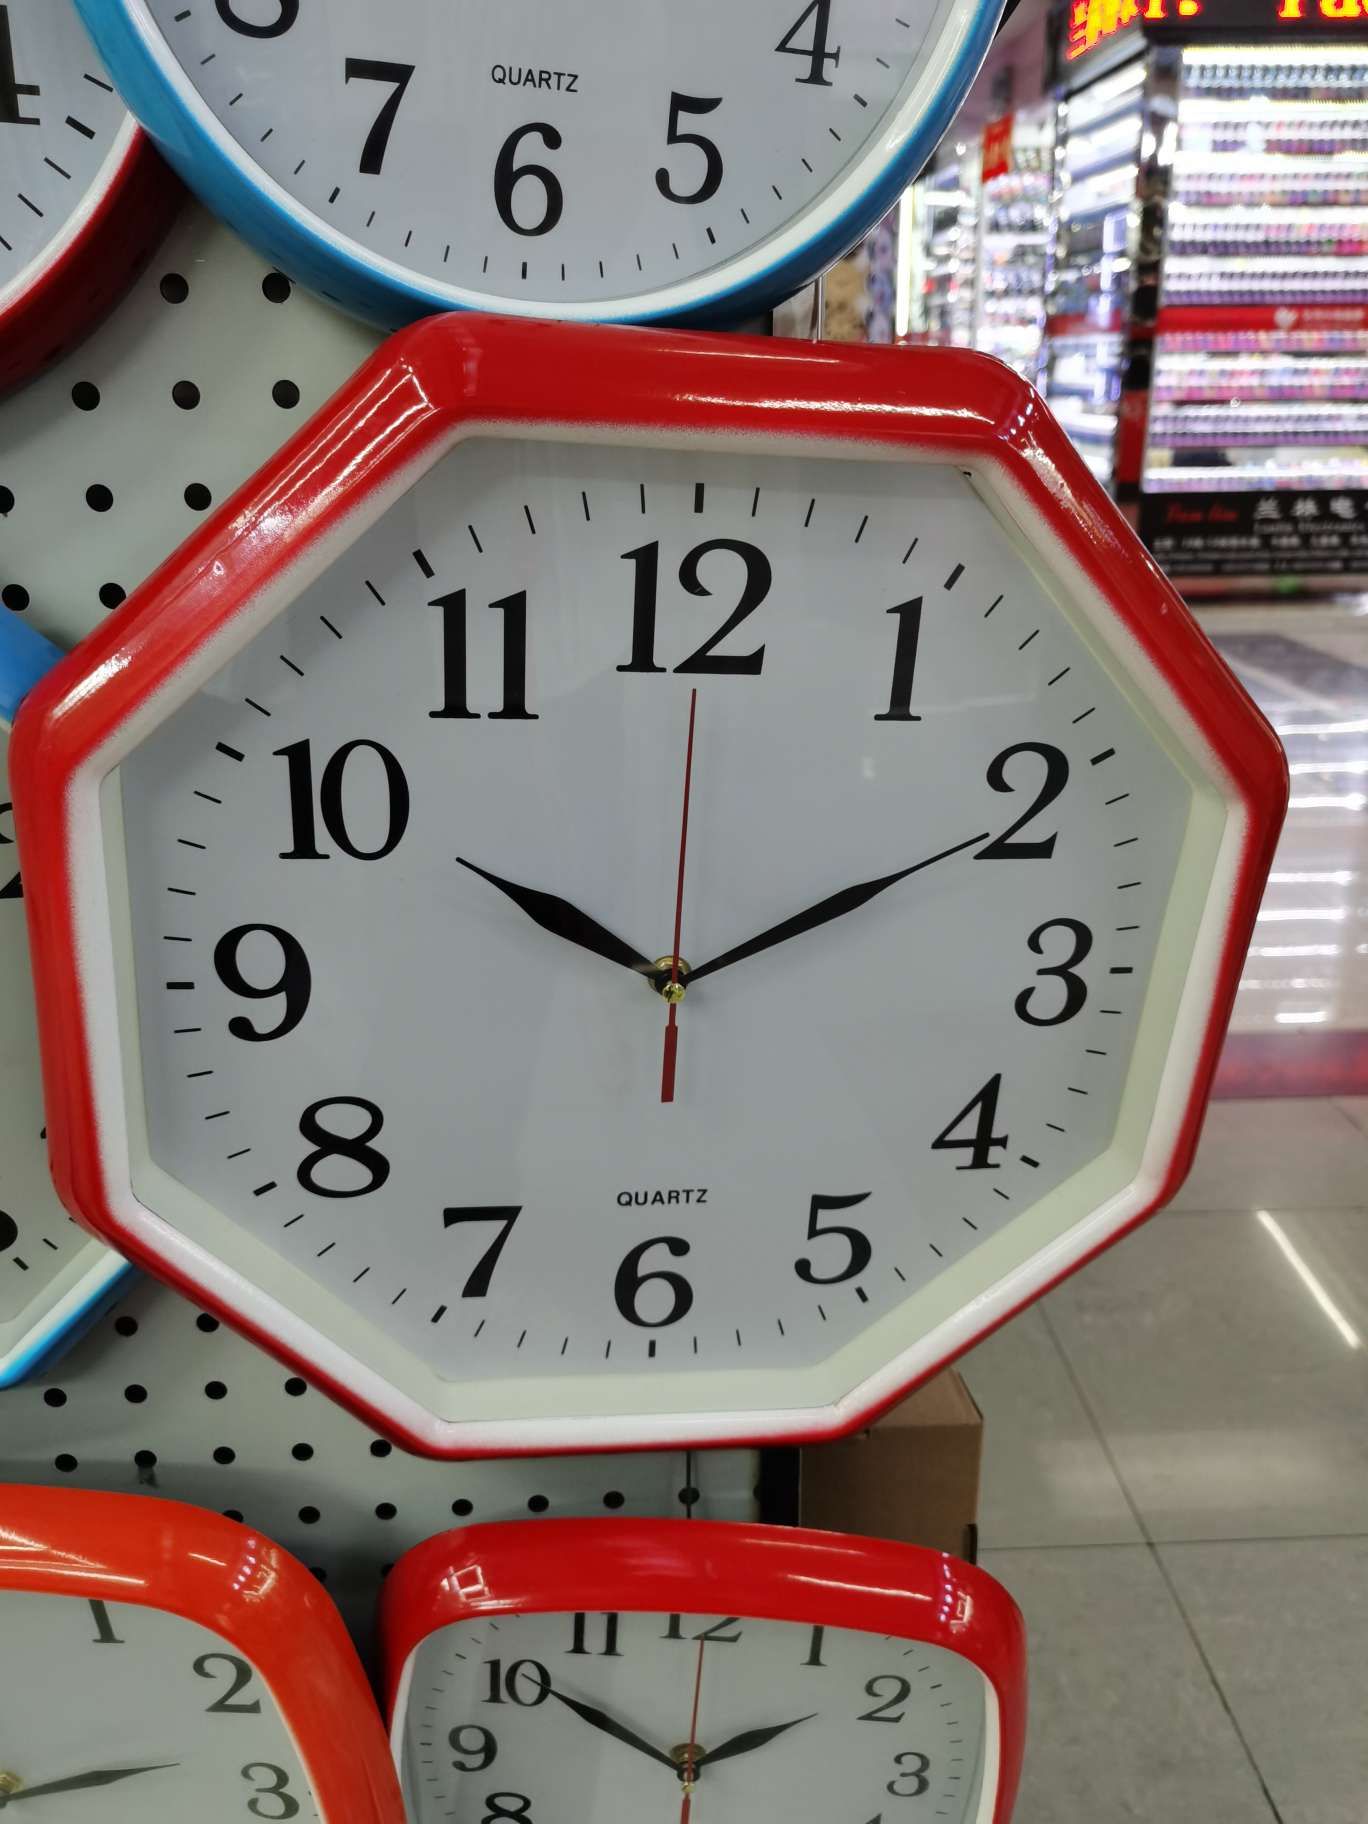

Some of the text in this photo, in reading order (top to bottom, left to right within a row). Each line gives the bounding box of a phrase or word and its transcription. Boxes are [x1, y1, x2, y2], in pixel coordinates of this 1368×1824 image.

[491, 64, 579, 93] QUARTZ
[775, 0, 841, 86] 4
[345, 57, 415, 175] 7
[655, 91, 723, 205] 5
[493, 122, 563, 237] 6
[427, 587, 540, 721] 11
[616, 539, 773, 676] 12
[874, 595, 924, 722] 1
[272, 738, 410, 862] 10
[973, 741, 1070, 861] 2
[214, 923, 312, 1043] 9
[1014, 917, 1093, 1027] 3
[297, 1095, 391, 1199] 8
[931, 1072, 1009, 1171] 4
[616, 1188, 708, 1207] QUARTZ
[794, 1191, 872, 1286] 5
[443, 1205, 522, 1299] 7
[614, 1235, 694, 1328] 6
[564, 1612, 624, 1657] 11
[799, 1624, 829, 1668] 1
[193, 1652, 262, 1714] 2
[481, 1657, 553, 1708] 10
[856, 1674, 912, 1724] 2
[242, 1762, 300, 1821] 3
[447, 1723, 498, 1773] 9
[886, 1751, 931, 1798] 3
